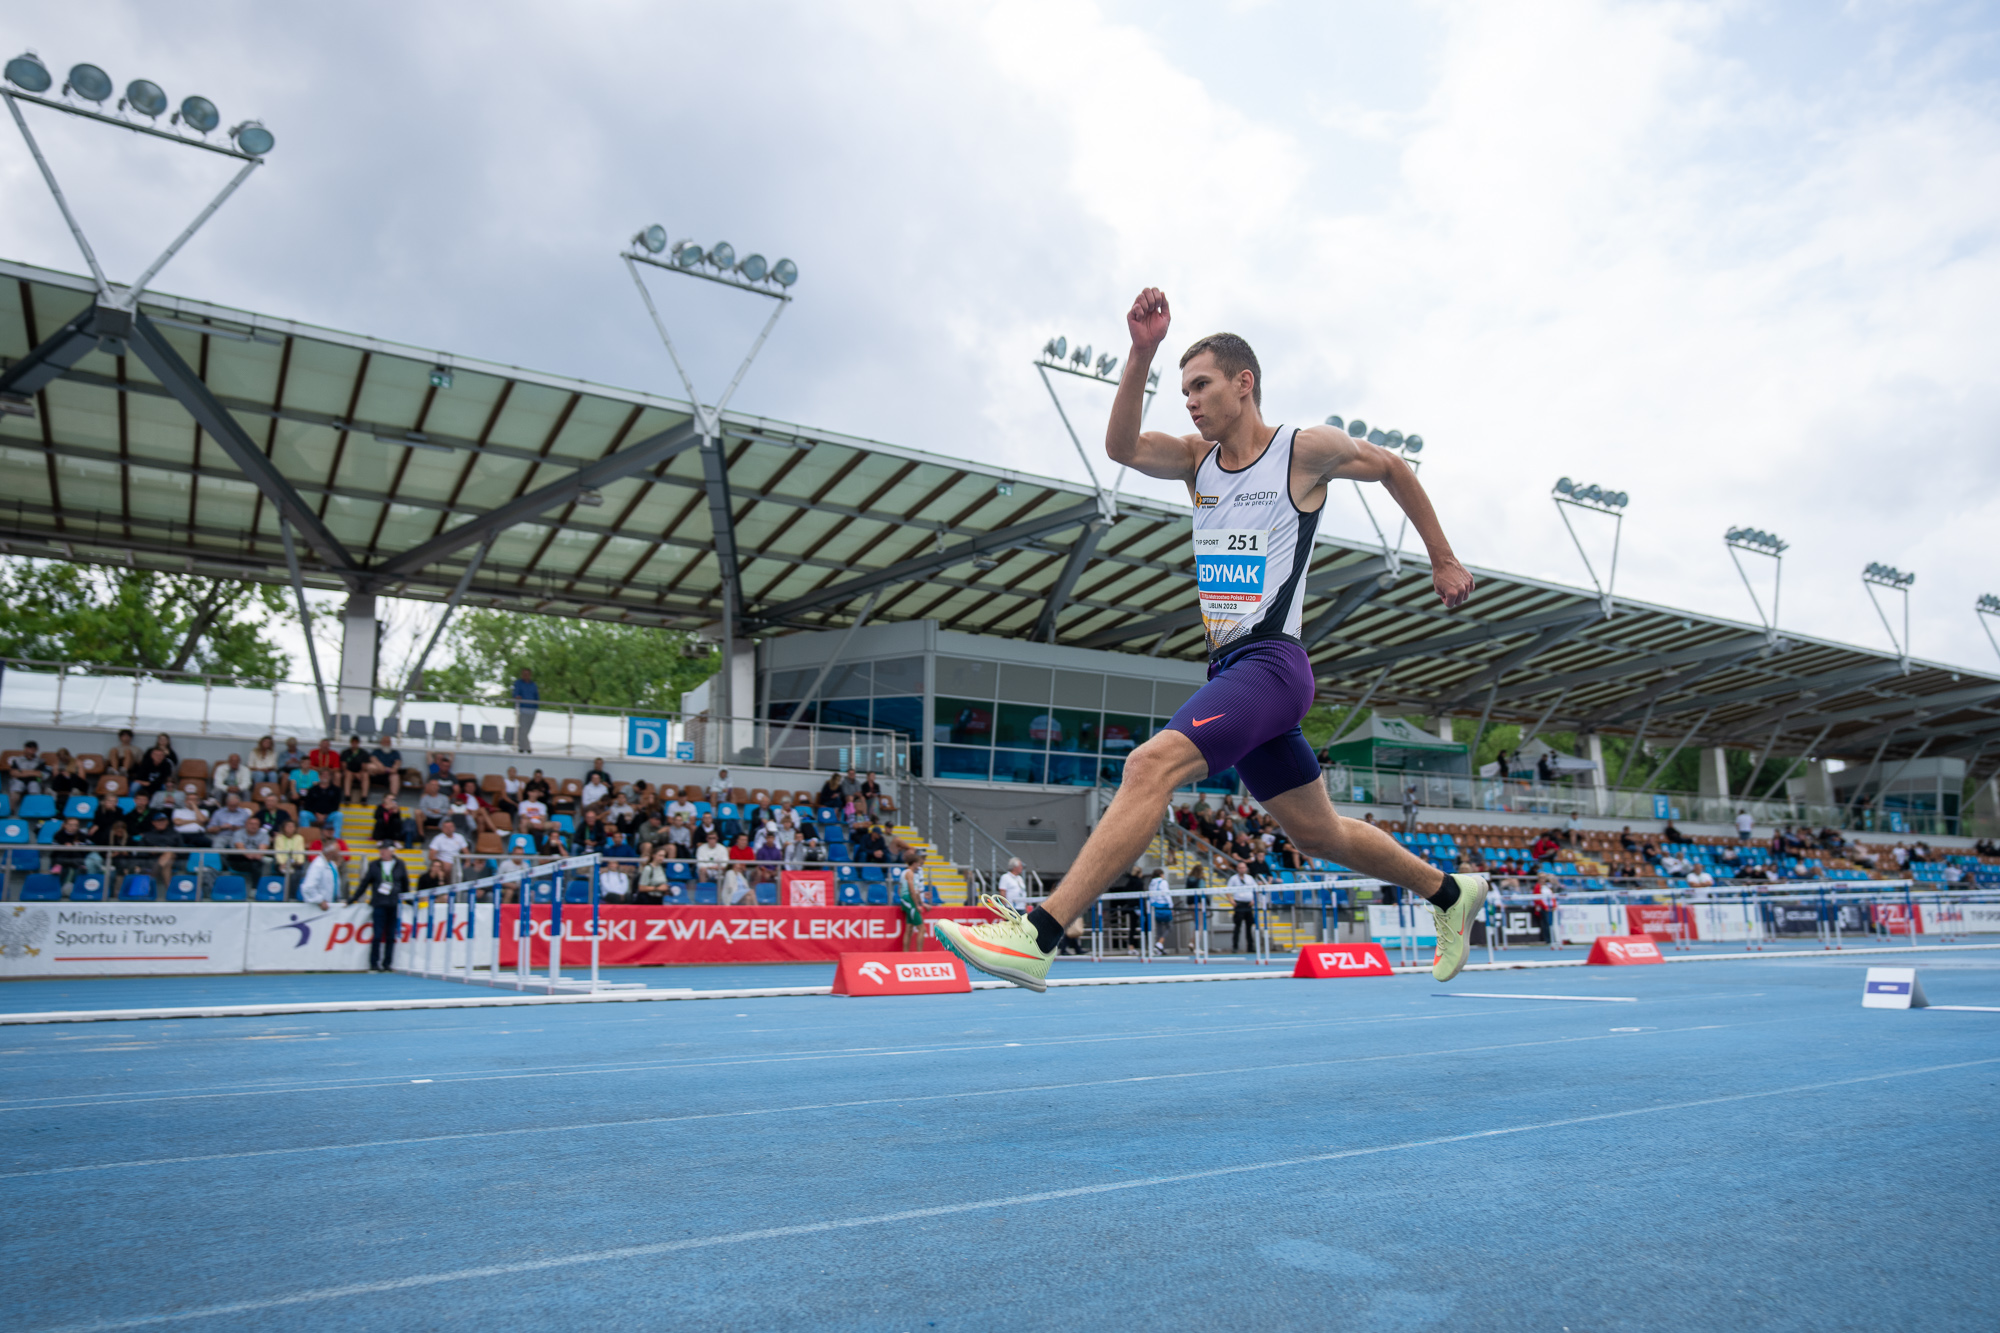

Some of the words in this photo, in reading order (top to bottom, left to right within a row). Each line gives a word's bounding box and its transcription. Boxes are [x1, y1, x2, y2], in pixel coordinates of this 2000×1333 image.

[1228, 534, 1258, 551] 251
[1199, 564, 1260, 584] JEDYNAK
[635, 728, 661, 755] D
[57, 911, 177, 926] Ministerstwo
[55, 930, 117, 946] Sportu
[122, 930, 128, 944] i
[133, 929, 212, 946] Turystyki
[513, 919, 636, 941] POLSKI
[645, 919, 788, 944] ZWIĄZEK
[793, 919, 901, 940] LEKKIEJ
[1318, 951, 1382, 970] PZLA
[901, 965, 951, 979] ORLEN
